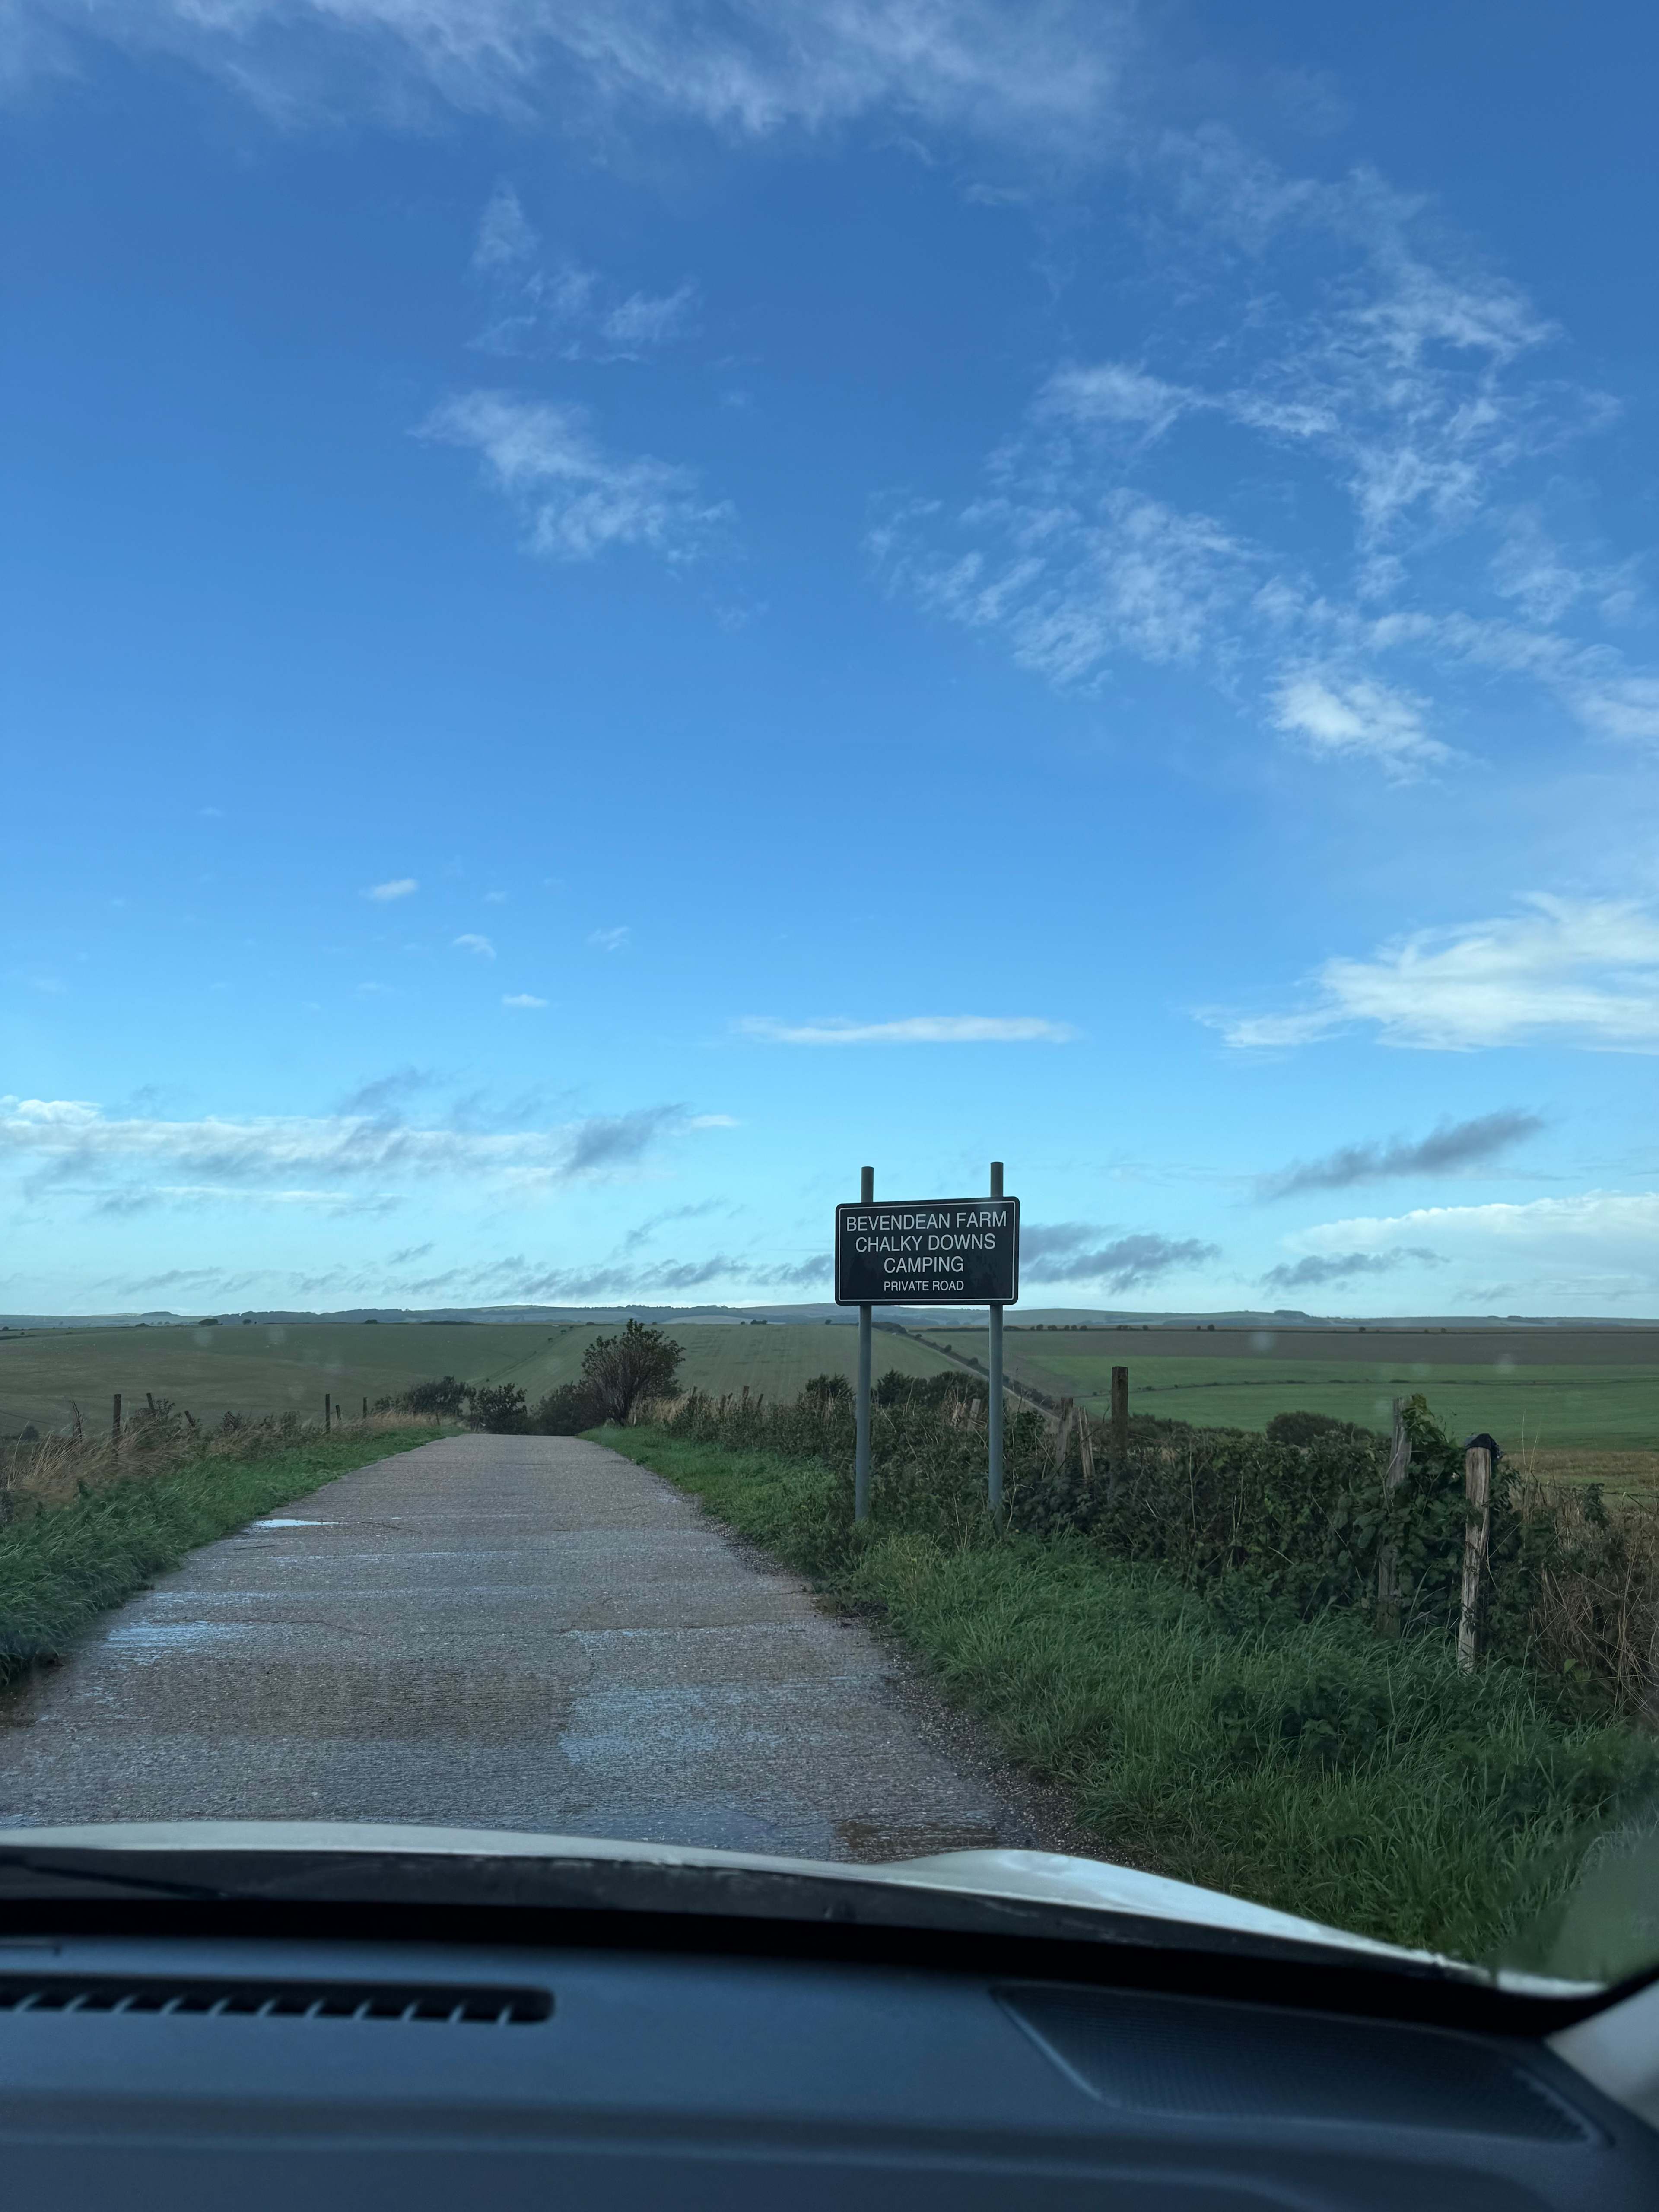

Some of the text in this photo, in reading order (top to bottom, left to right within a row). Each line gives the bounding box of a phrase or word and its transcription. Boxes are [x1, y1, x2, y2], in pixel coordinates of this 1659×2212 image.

[846, 1211, 1007, 1232] BEVENDEAN FARM
[855, 1233, 996, 1252] CHALKY DOWNS
[884, 1256, 964, 1273] CAMPING
[884, 1280, 964, 1291] PRIVATE ROAD
